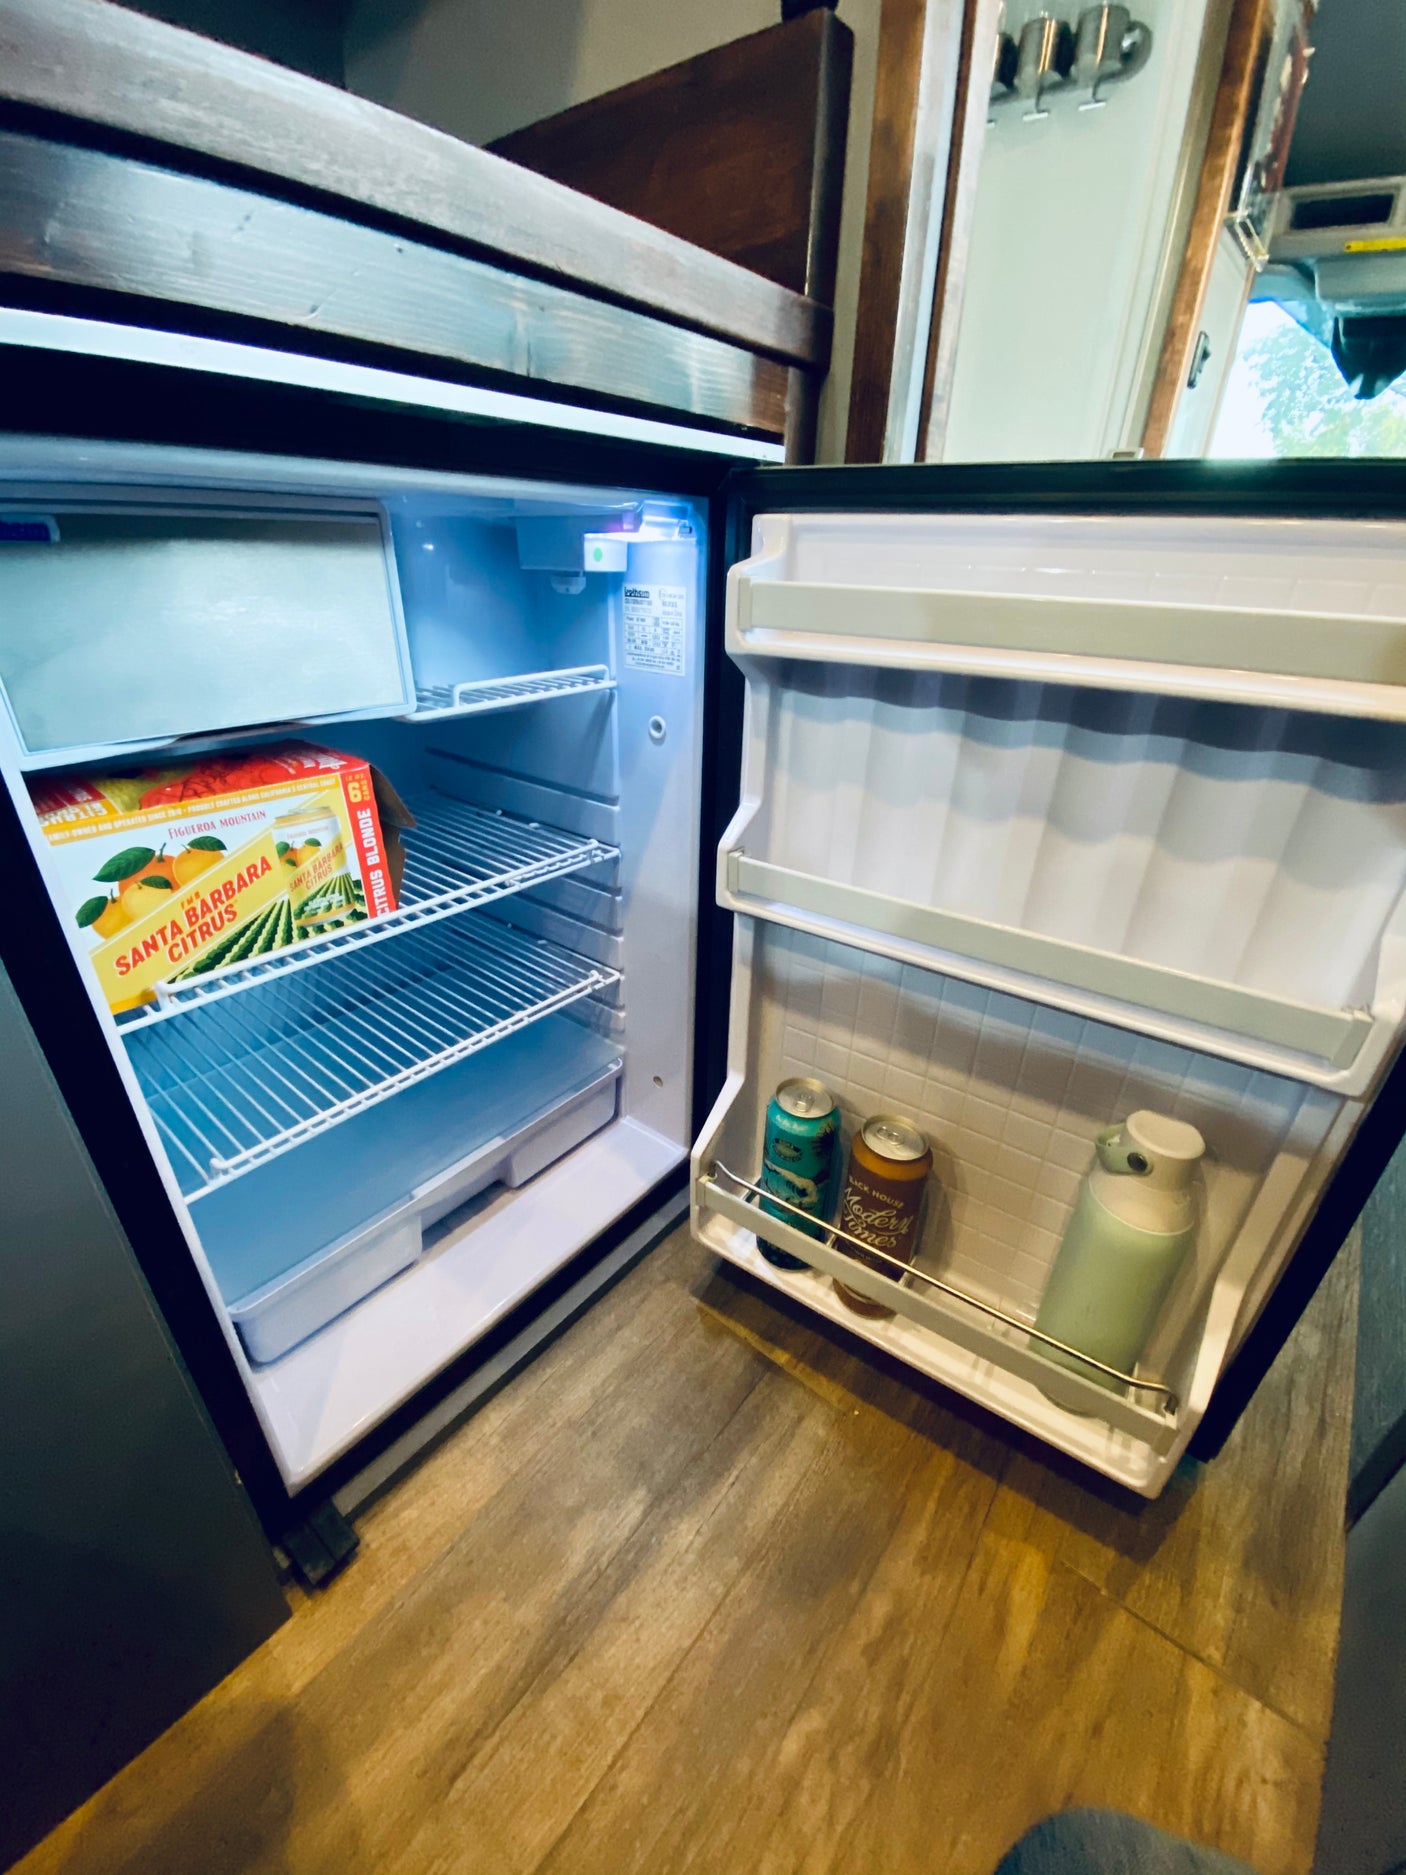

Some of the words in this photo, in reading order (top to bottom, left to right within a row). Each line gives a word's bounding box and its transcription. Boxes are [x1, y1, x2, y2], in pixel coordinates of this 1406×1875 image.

[347, 781, 362, 803] 6
[168, 821, 217, 840] FIGUEROA
[219, 810, 267, 828] MOUNTAIN
[357, 808, 380, 866] BLONDE
[289, 870, 312, 893] SANTA
[305, 863, 334, 890] CITRUS
[180, 891, 201, 910] THE
[369, 869, 390, 917] CITRUS
[115, 919, 184, 976] SANTA
[183, 855, 273, 928] BARBARA
[167, 903, 238, 963] CITRUS
[872, 1189, 905, 1208] HOUSE
